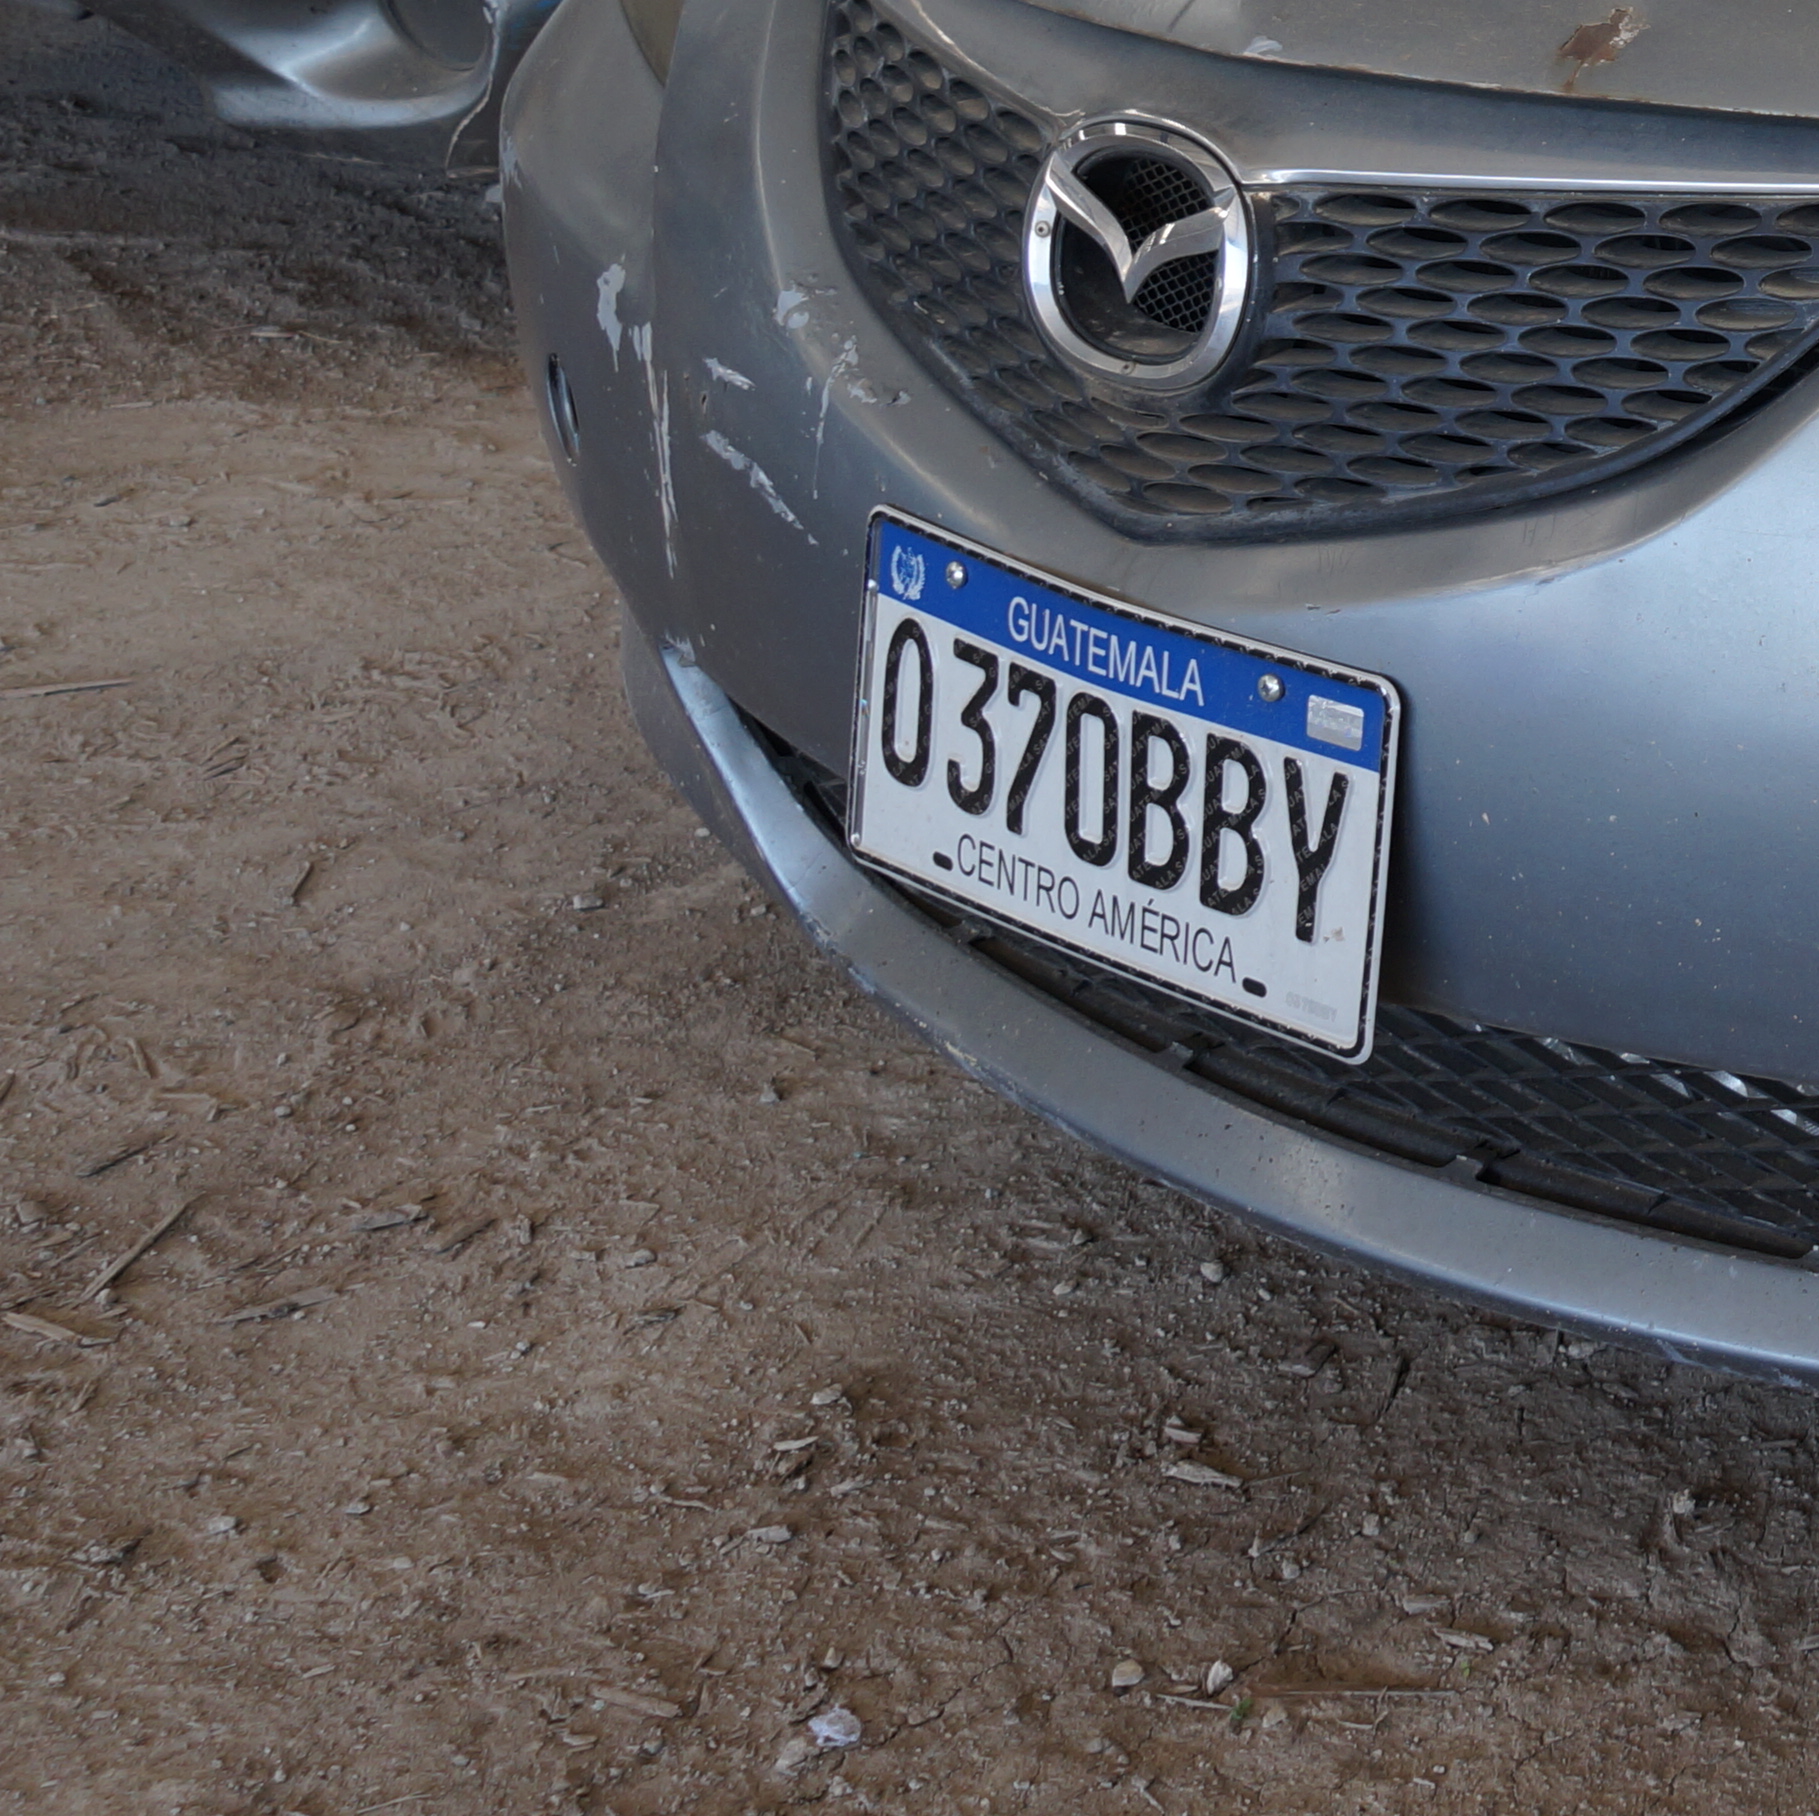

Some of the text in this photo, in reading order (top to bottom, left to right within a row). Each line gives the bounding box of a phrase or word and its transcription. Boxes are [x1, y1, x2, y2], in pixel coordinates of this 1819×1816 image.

[1007, 595, 1205, 707] GUATEMALA
[956, 833, 1238, 984] CENTRO AMÉRICA
